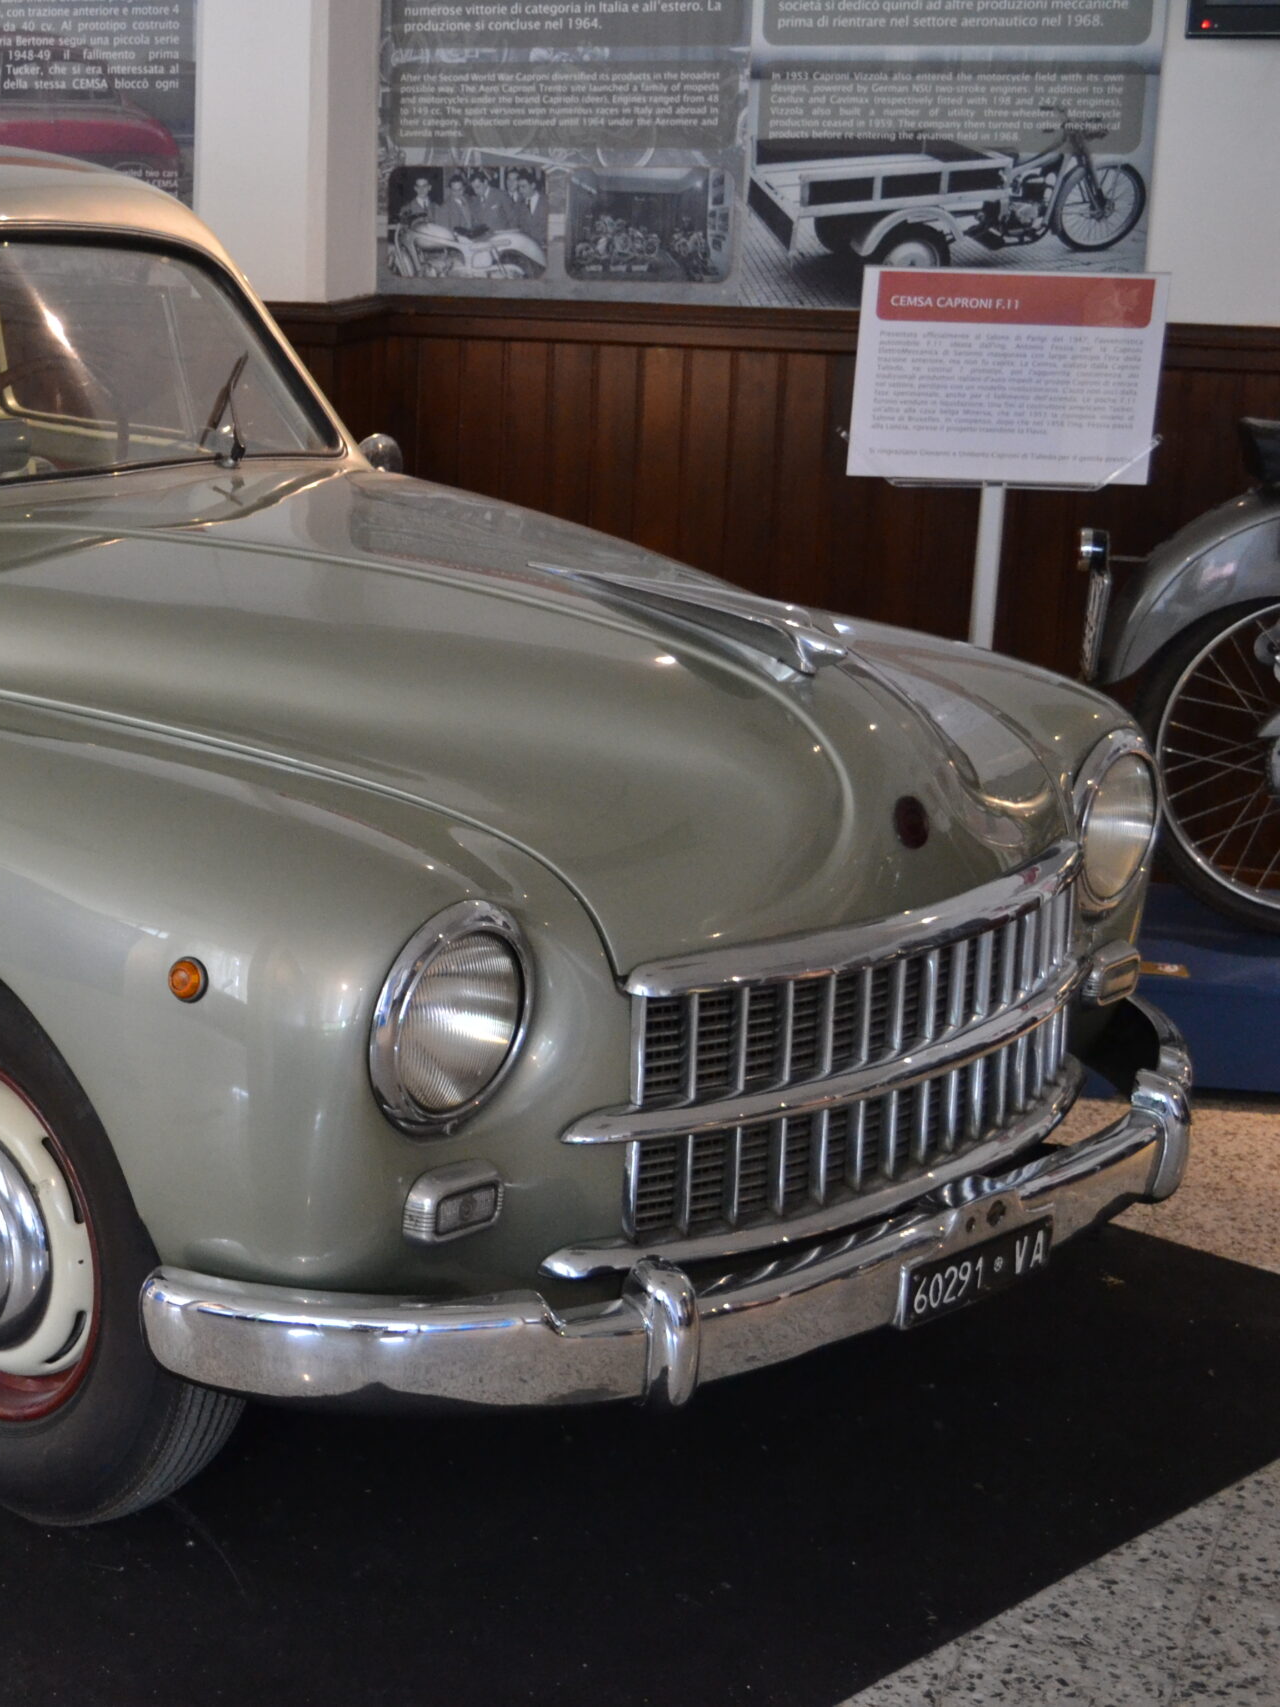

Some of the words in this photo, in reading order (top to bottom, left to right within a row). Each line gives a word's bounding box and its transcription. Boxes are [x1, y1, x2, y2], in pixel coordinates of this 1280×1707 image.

[6, 9, 25, 18] con
[27, 7, 70, 17] trazione
[73, 6, 119, 16] anteriore
[122, 8, 129, 16] e
[131, 6, 170, 15] motore
[172, 4, 179, 14] 4
[404, 6, 462, 16] numerose
[465, 4, 507, 15] vittorie
[510, 2, 522, 15] di
[525, 3, 581, 16] categoria
[584, 2, 595, 13] in
[599, 1, 629, 13] Italia
[631, 4, 639, 13] e
[642, 0, 703, 12] all'estero.
[707, 0, 722, 11] La
[3, 21, 16, 32] da
[21, 21, 35, 31] 40
[40, 23, 55, 31] cv.
[61, 20, 72, 31] Al
[78, 21, 127, 34] prototipo
[132, 20, 180, 30] costruito
[404, 21, 470, 33] produzione
[475, 21, 484, 31] si
[488, 20, 541, 31] concluse
[545, 19, 563, 30] nel
[568, 18, 603, 30] 1964.
[777, 16, 813, 30] prima
[817, 15, 829, 28] di
[832, 16, 886, 28] rientrare
[890, 15, 909, 27] nel
[912, 16, 957, 27] settore
[961, 16, 1038, 27] aeronautico
[1041, 14, 1061, 27] nel
[1067, 14, 1103, 27] 1968.
[16, 36, 55, 46] Bertone
[90, 37, 109, 45] una
[113, 35, 150, 47] piccola
[154, 35, 179, 45] serie
[8, 50, 51, 60] 1948-49
[63, 49, 70, 60] il
[83, 49, 136, 60] fallimento
[148, 50, 179, 61] prima
[5, 64, 44, 76] Tucker,
[48, 63, 67, 74] che
[72, 64, 80, 74] si
[85, 66, 102, 74] era
[107, 64, 165, 74] interessata
[169, 63, 179, 74] al
[3, 79, 28, 89] della
[34, 80, 66, 89] stessa
[72, 79, 108, 89] CEMSA
[155, 79, 179, 91] ogni
[890, 295, 933, 308] CEMSA
[936, 296, 992, 309] CAPRONI
[995, 298, 1020, 310] F.11
[913, 1256, 984, 1314] 60291
[1015, 1229, 1044, 1275] VA
